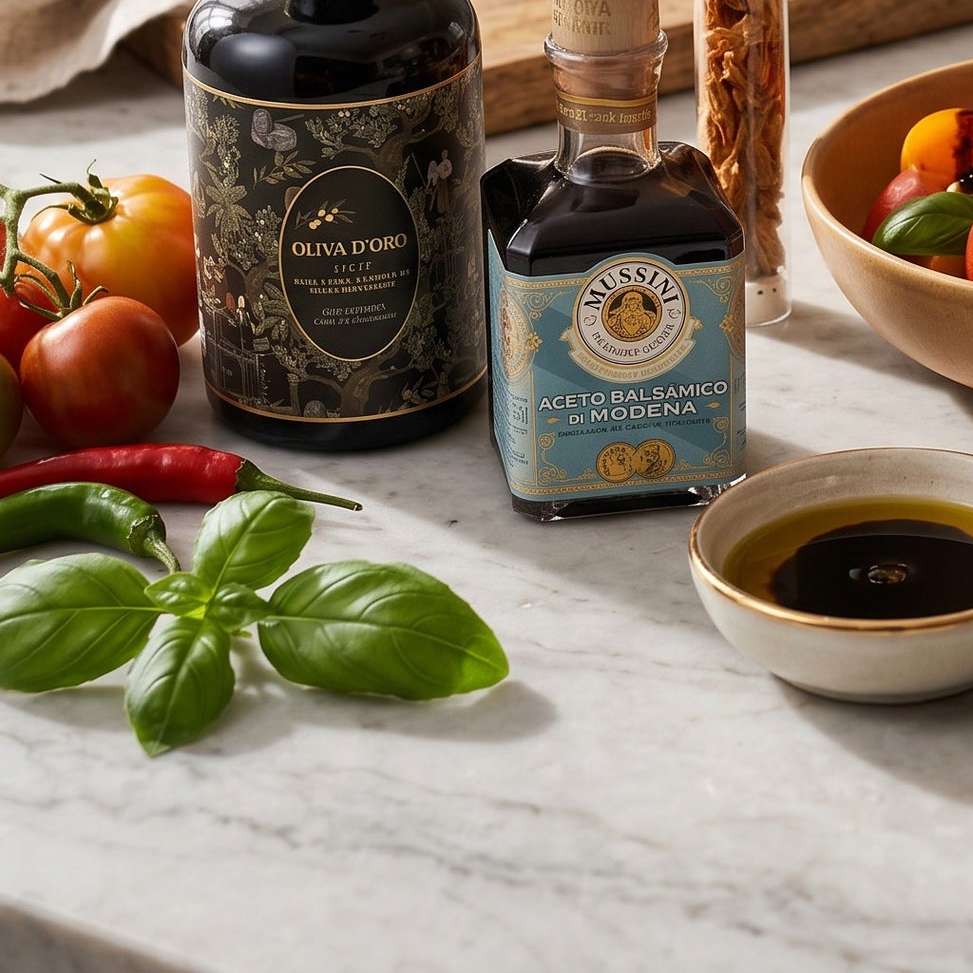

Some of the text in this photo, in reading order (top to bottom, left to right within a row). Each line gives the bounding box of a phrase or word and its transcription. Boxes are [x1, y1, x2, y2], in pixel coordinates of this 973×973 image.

[291, 233, 407, 257] OLIVA D'ORO
[584, 267, 680, 311] MUSSINI
[538, 392, 606, 412] ACETO
[610, 380, 729, 405] BALSÁMICO
[568, 401, 697, 426] DI MODENA
